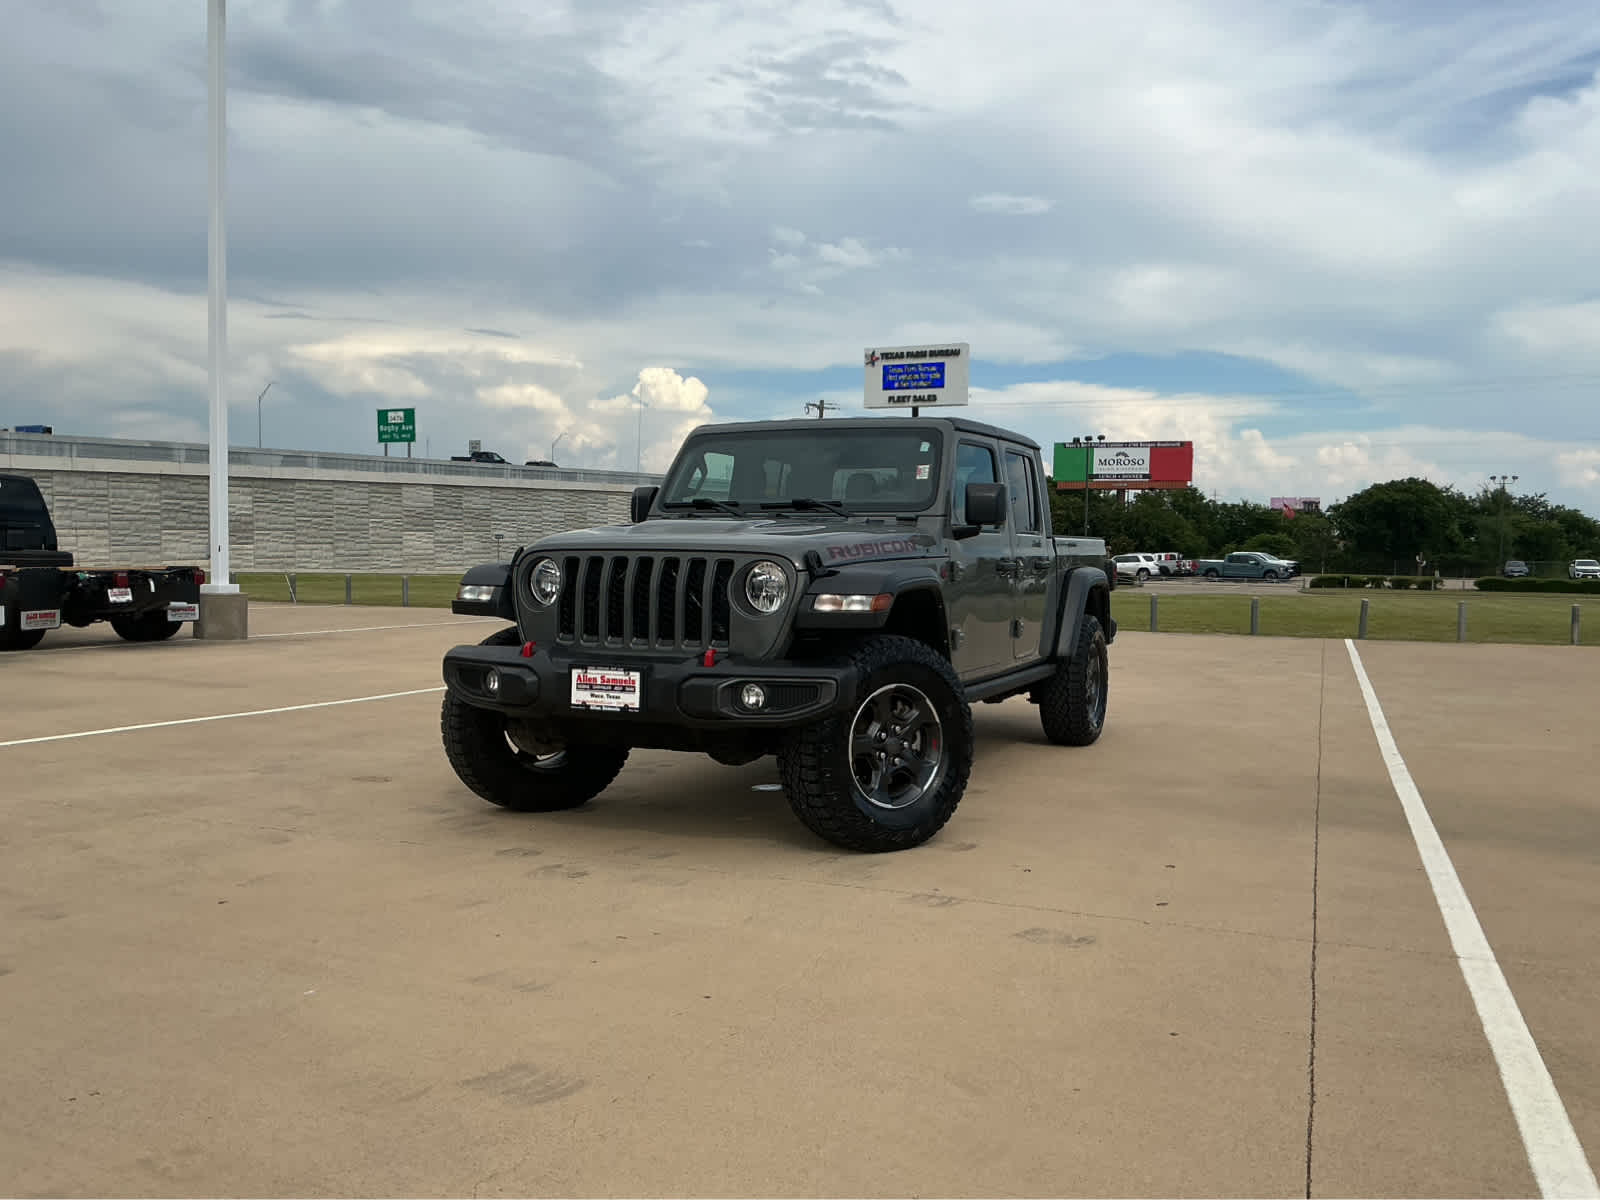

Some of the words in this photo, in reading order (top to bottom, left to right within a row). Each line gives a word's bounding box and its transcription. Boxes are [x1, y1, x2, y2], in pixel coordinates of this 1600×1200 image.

[880, 351, 904, 360] TEXAS
[906, 350, 928, 360] FARM
[929, 348, 960, 358] BUREAU
[888, 395, 911, 403] FLEET
[912, 394, 937, 402] SALES
[1098, 458, 1145, 467] MOROSO
[827, 540, 917, 560] RUBICON
[576, 674, 597, 683] Allen
[600, 675, 636, 685] Samuels
